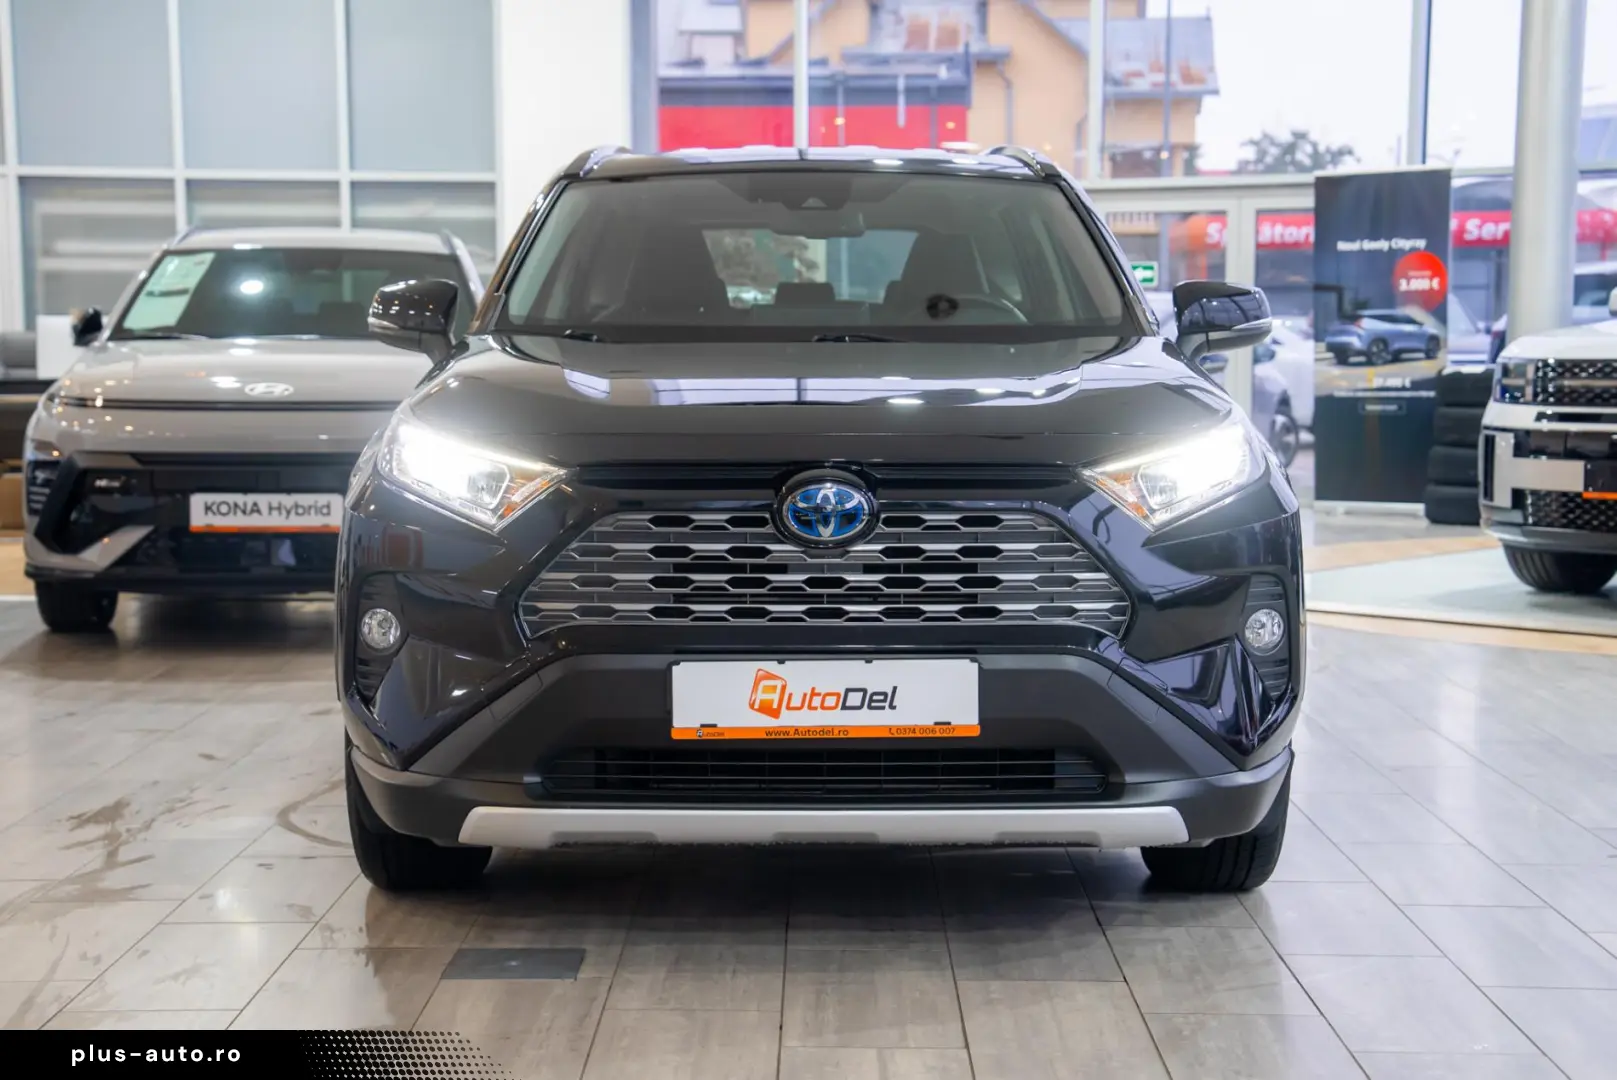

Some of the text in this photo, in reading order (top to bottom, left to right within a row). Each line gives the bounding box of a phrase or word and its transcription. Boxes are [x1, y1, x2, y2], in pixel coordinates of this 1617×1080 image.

[204, 500, 331, 520] KONA Hybrid
[750, 672, 898, 715] AutoDel
[765, 728, 849, 737] www.Autodel.ro
[896, 727, 957, 736] 0374 006 007
